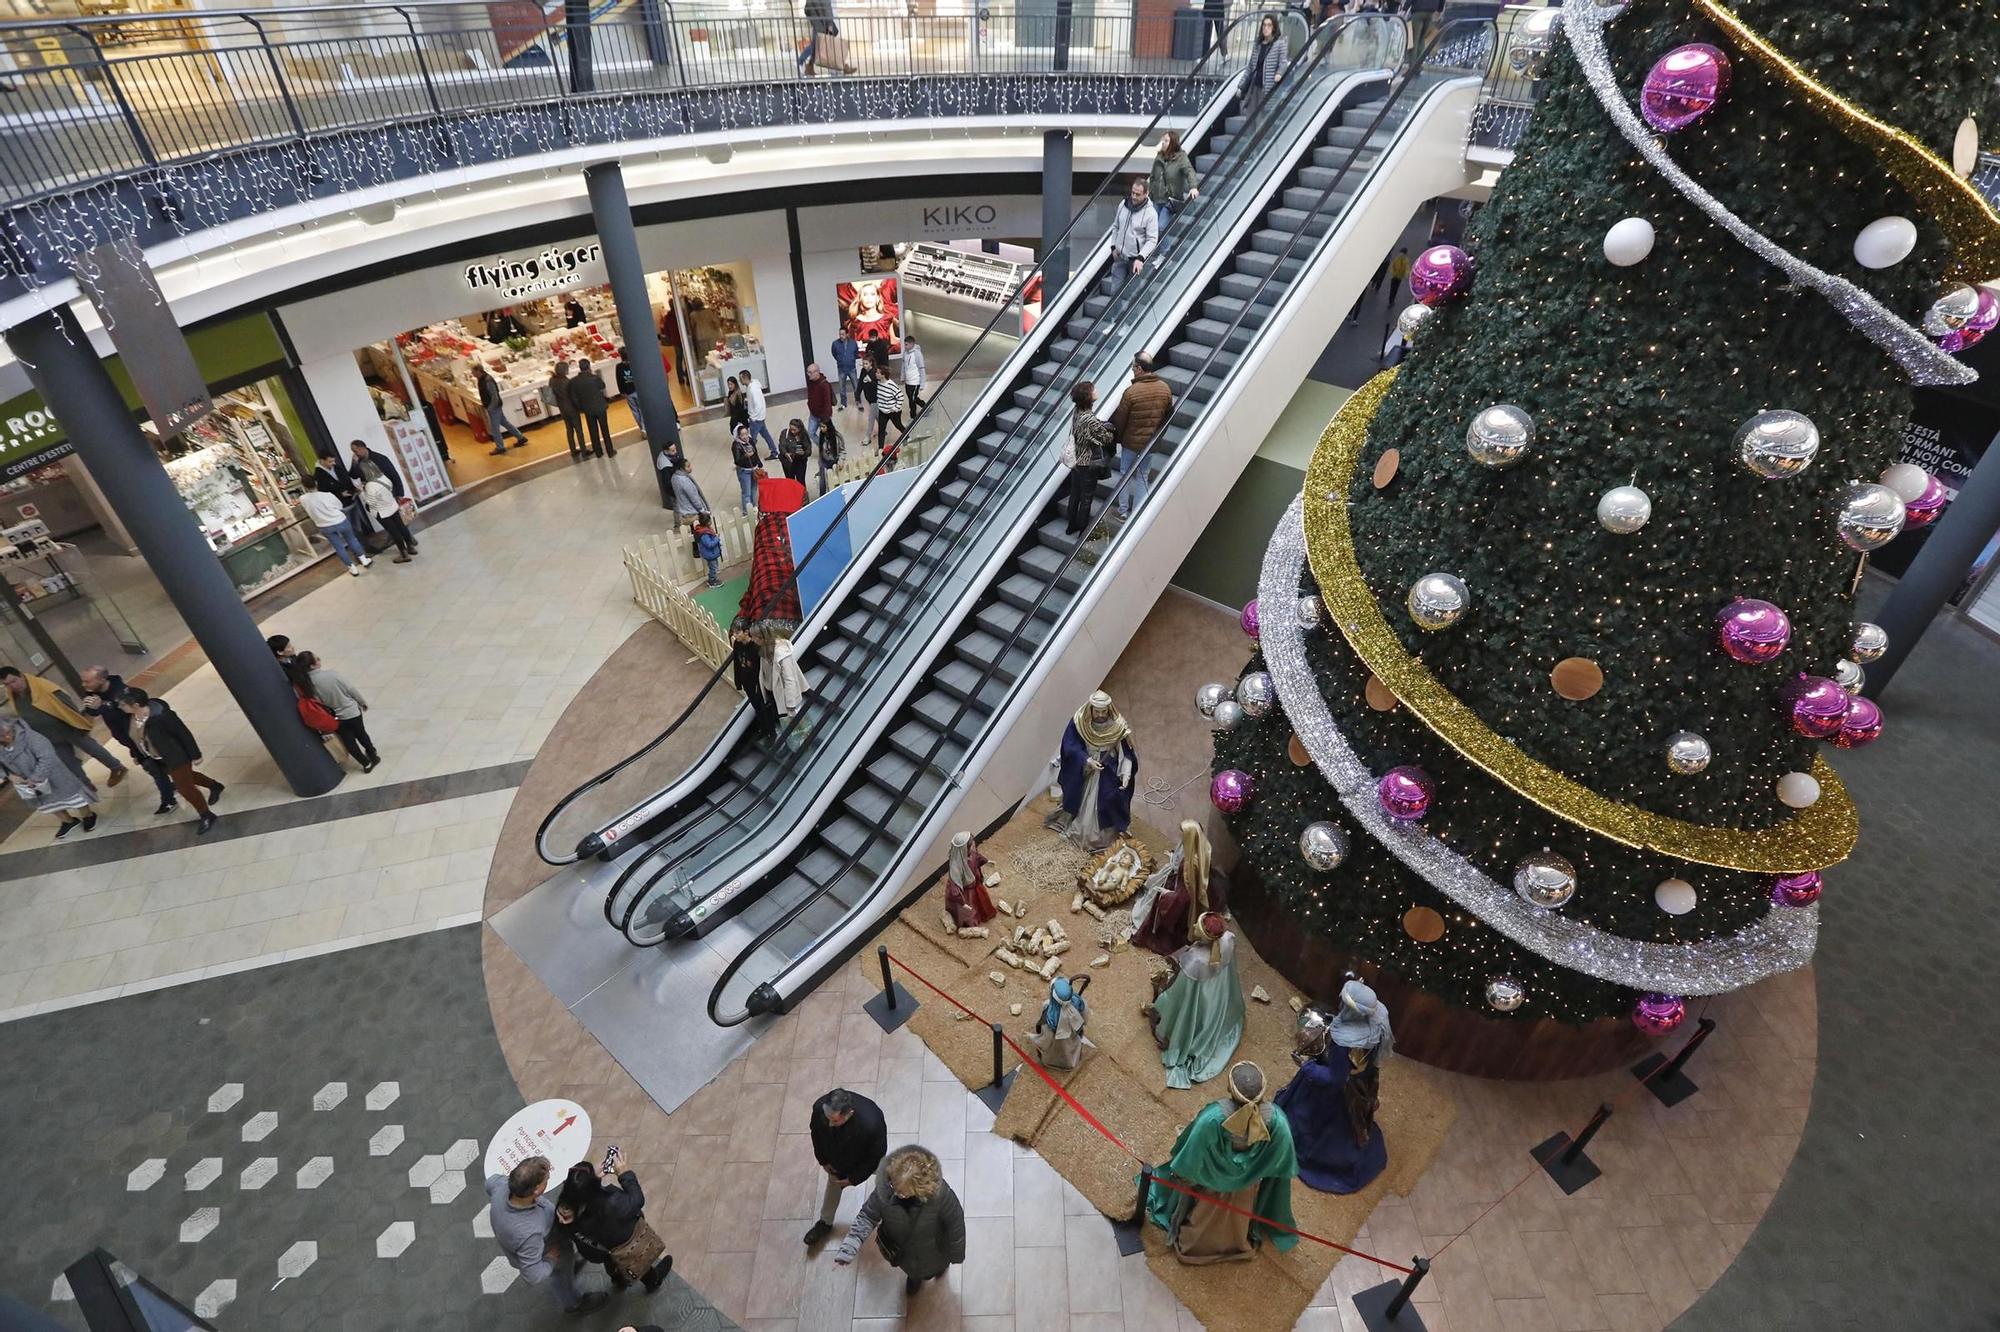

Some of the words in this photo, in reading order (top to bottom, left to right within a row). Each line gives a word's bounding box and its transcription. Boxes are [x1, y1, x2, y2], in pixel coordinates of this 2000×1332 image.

[923, 205, 996, 226] KIKO
[466, 259, 540, 289] flying
[542, 246, 600, 272] tiger
[502, 273, 582, 298] copenhagen
[1905, 422, 1941, 442] S'ESTÀ
[7, 456, 40, 475] CENTRE
[1912, 449, 1940, 465] NOU
